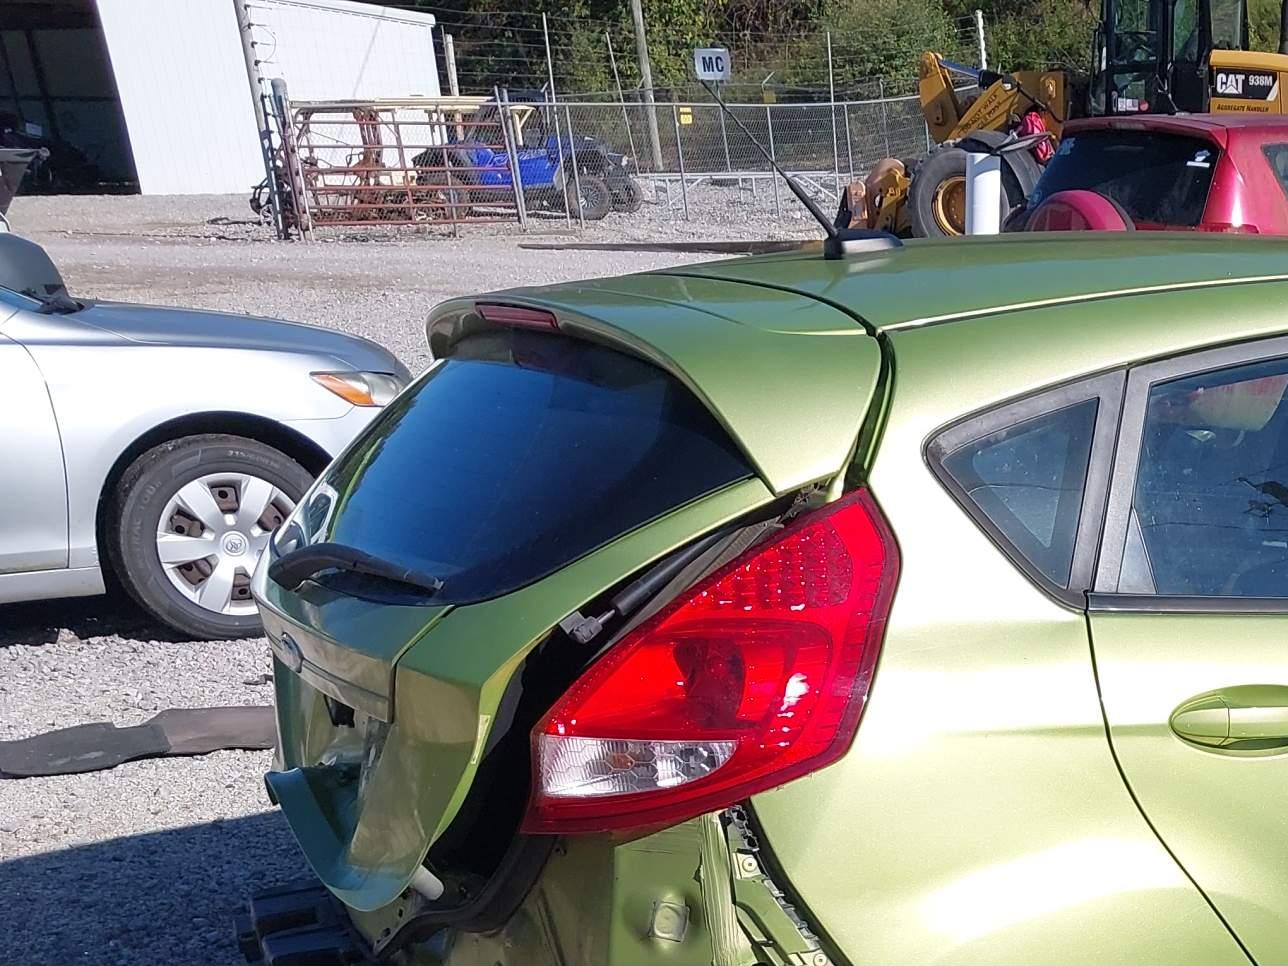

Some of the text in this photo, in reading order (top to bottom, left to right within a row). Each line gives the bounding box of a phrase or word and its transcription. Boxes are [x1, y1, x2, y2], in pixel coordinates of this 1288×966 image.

[702, 55, 724, 73] MC
[1216, 72, 1273, 94] CAT 938M
